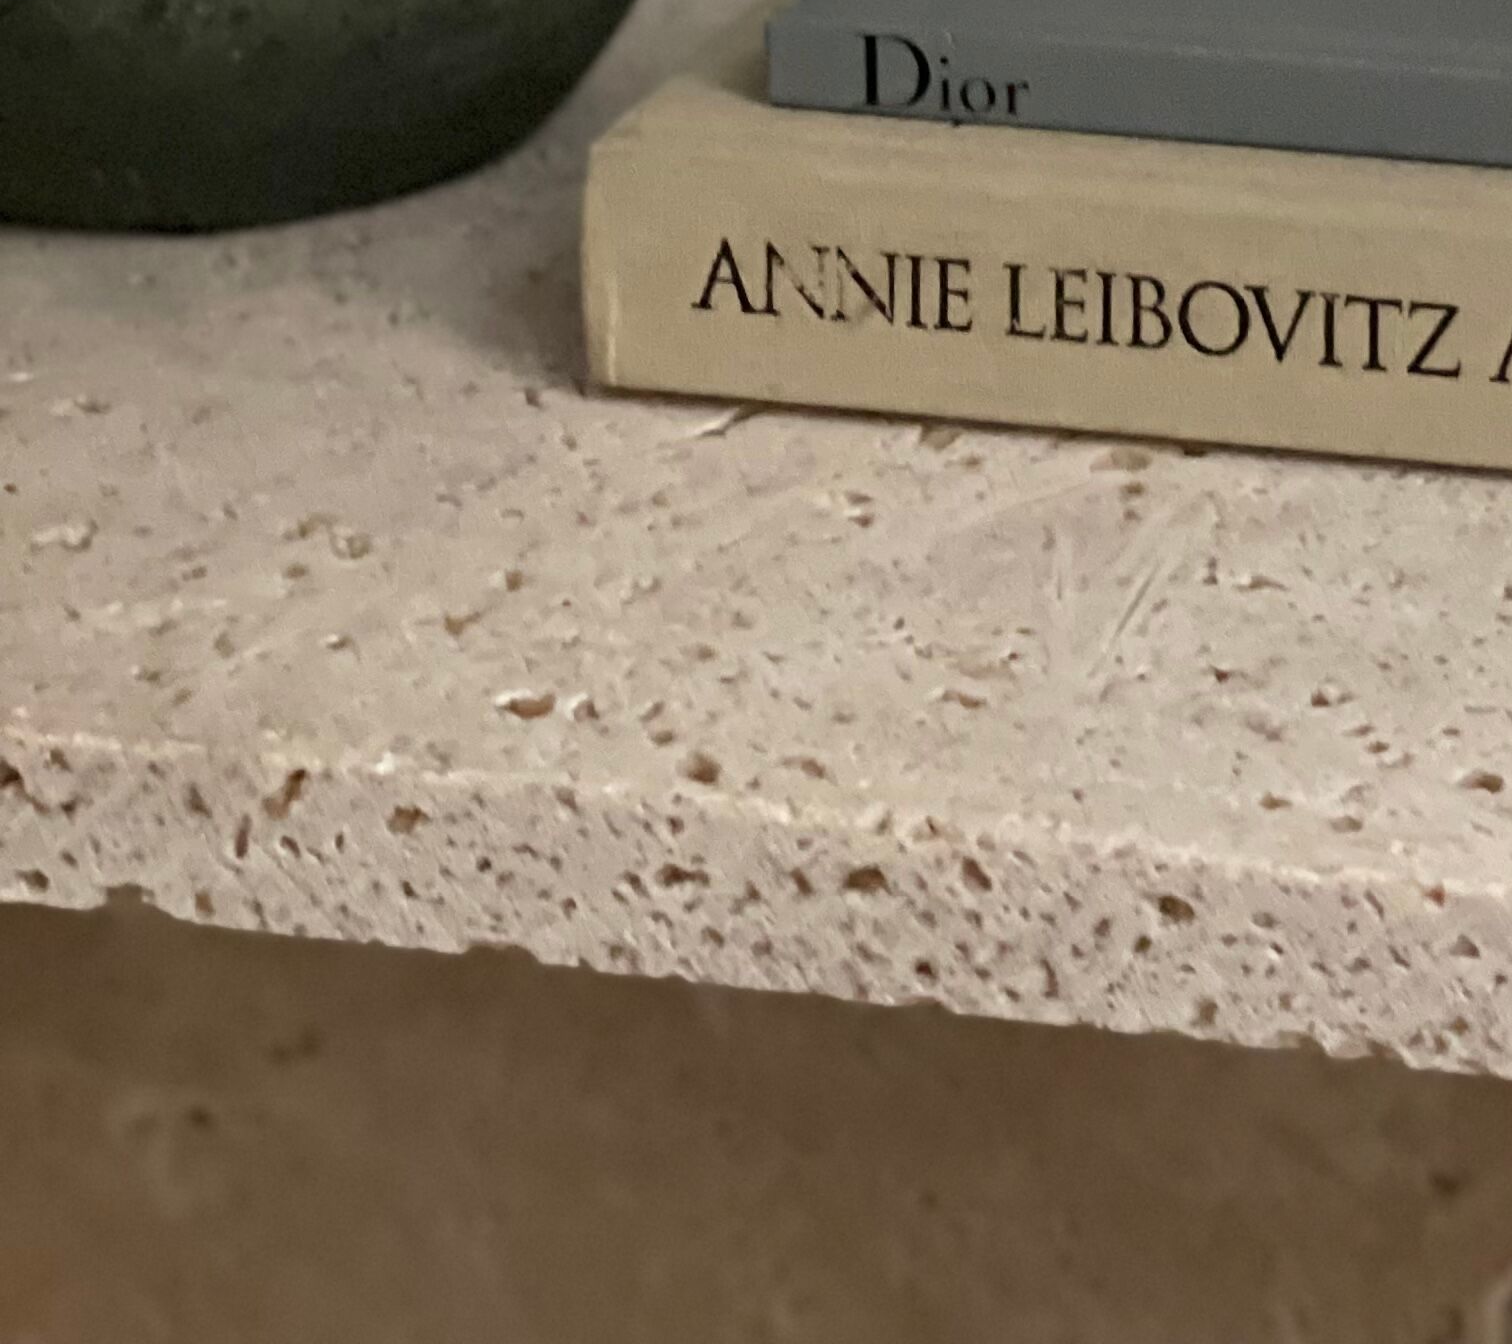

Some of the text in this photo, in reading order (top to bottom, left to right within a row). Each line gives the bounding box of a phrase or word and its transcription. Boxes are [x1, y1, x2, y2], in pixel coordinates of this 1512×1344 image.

[860, 33, 1030, 115] Dior
[690, 236, 974, 334] ANNIE
[1002, 261, 1461, 381] LEIBOVITZ
